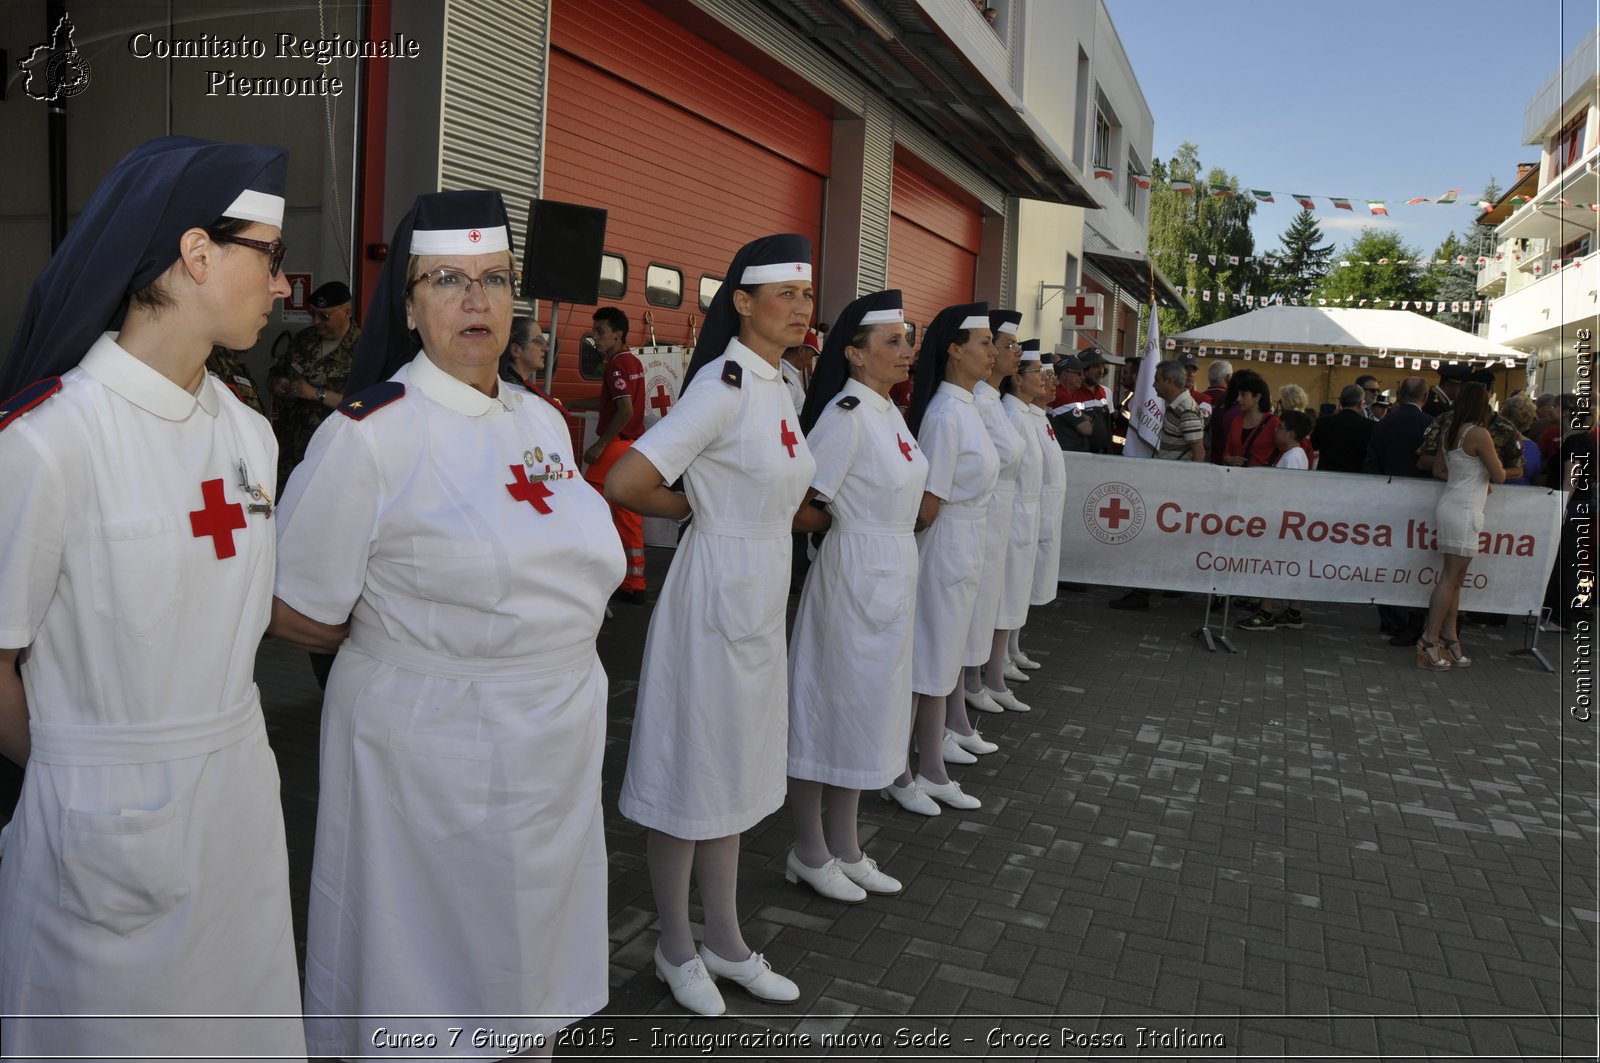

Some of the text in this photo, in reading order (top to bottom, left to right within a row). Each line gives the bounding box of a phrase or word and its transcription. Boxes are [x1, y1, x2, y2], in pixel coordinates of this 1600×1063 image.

[1094, 488, 1103, 498] DI
[1156, 502, 1267, 538] Croce
[1278, 510, 1393, 548] Rossa
